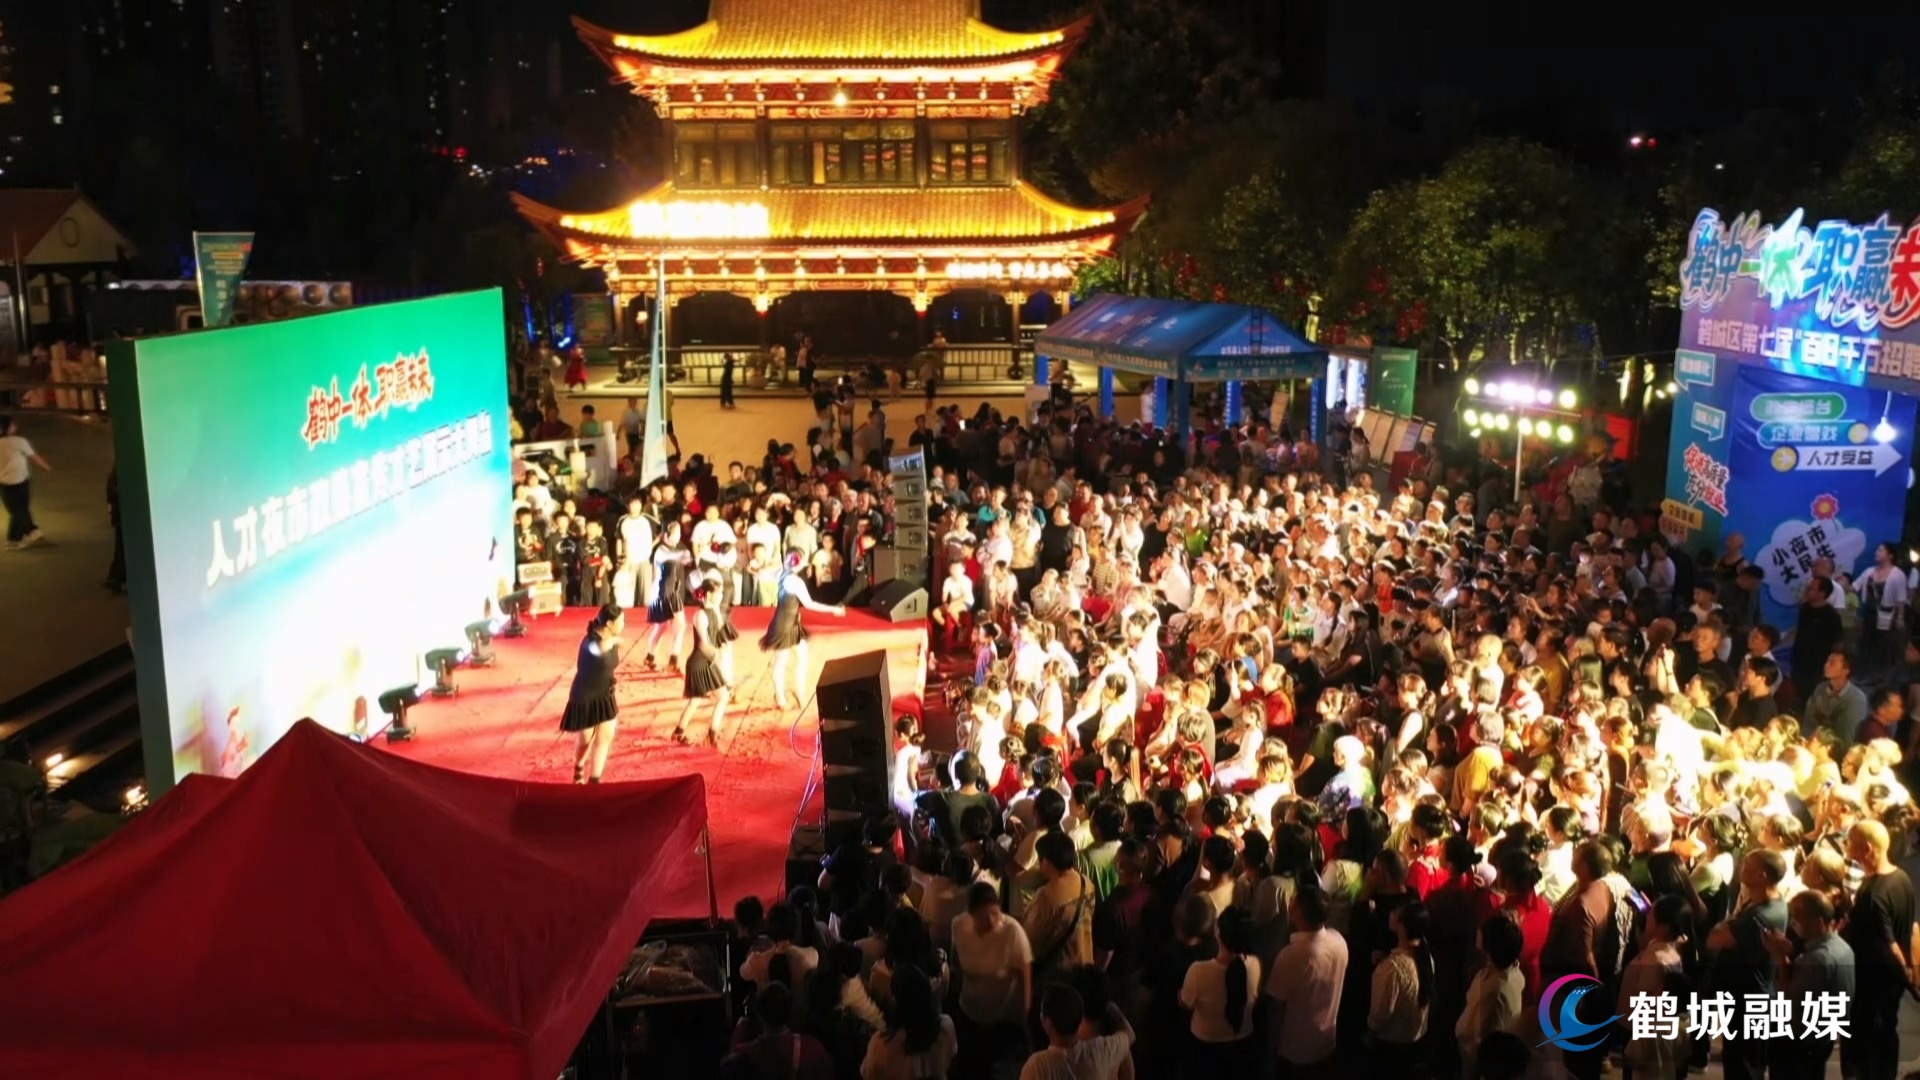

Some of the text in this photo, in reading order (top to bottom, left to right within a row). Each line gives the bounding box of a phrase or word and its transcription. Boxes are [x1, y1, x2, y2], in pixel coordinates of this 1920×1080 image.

[1807, 450, 1874, 467] 人才受益
[1772, 525, 1826, 566] 小夜市
